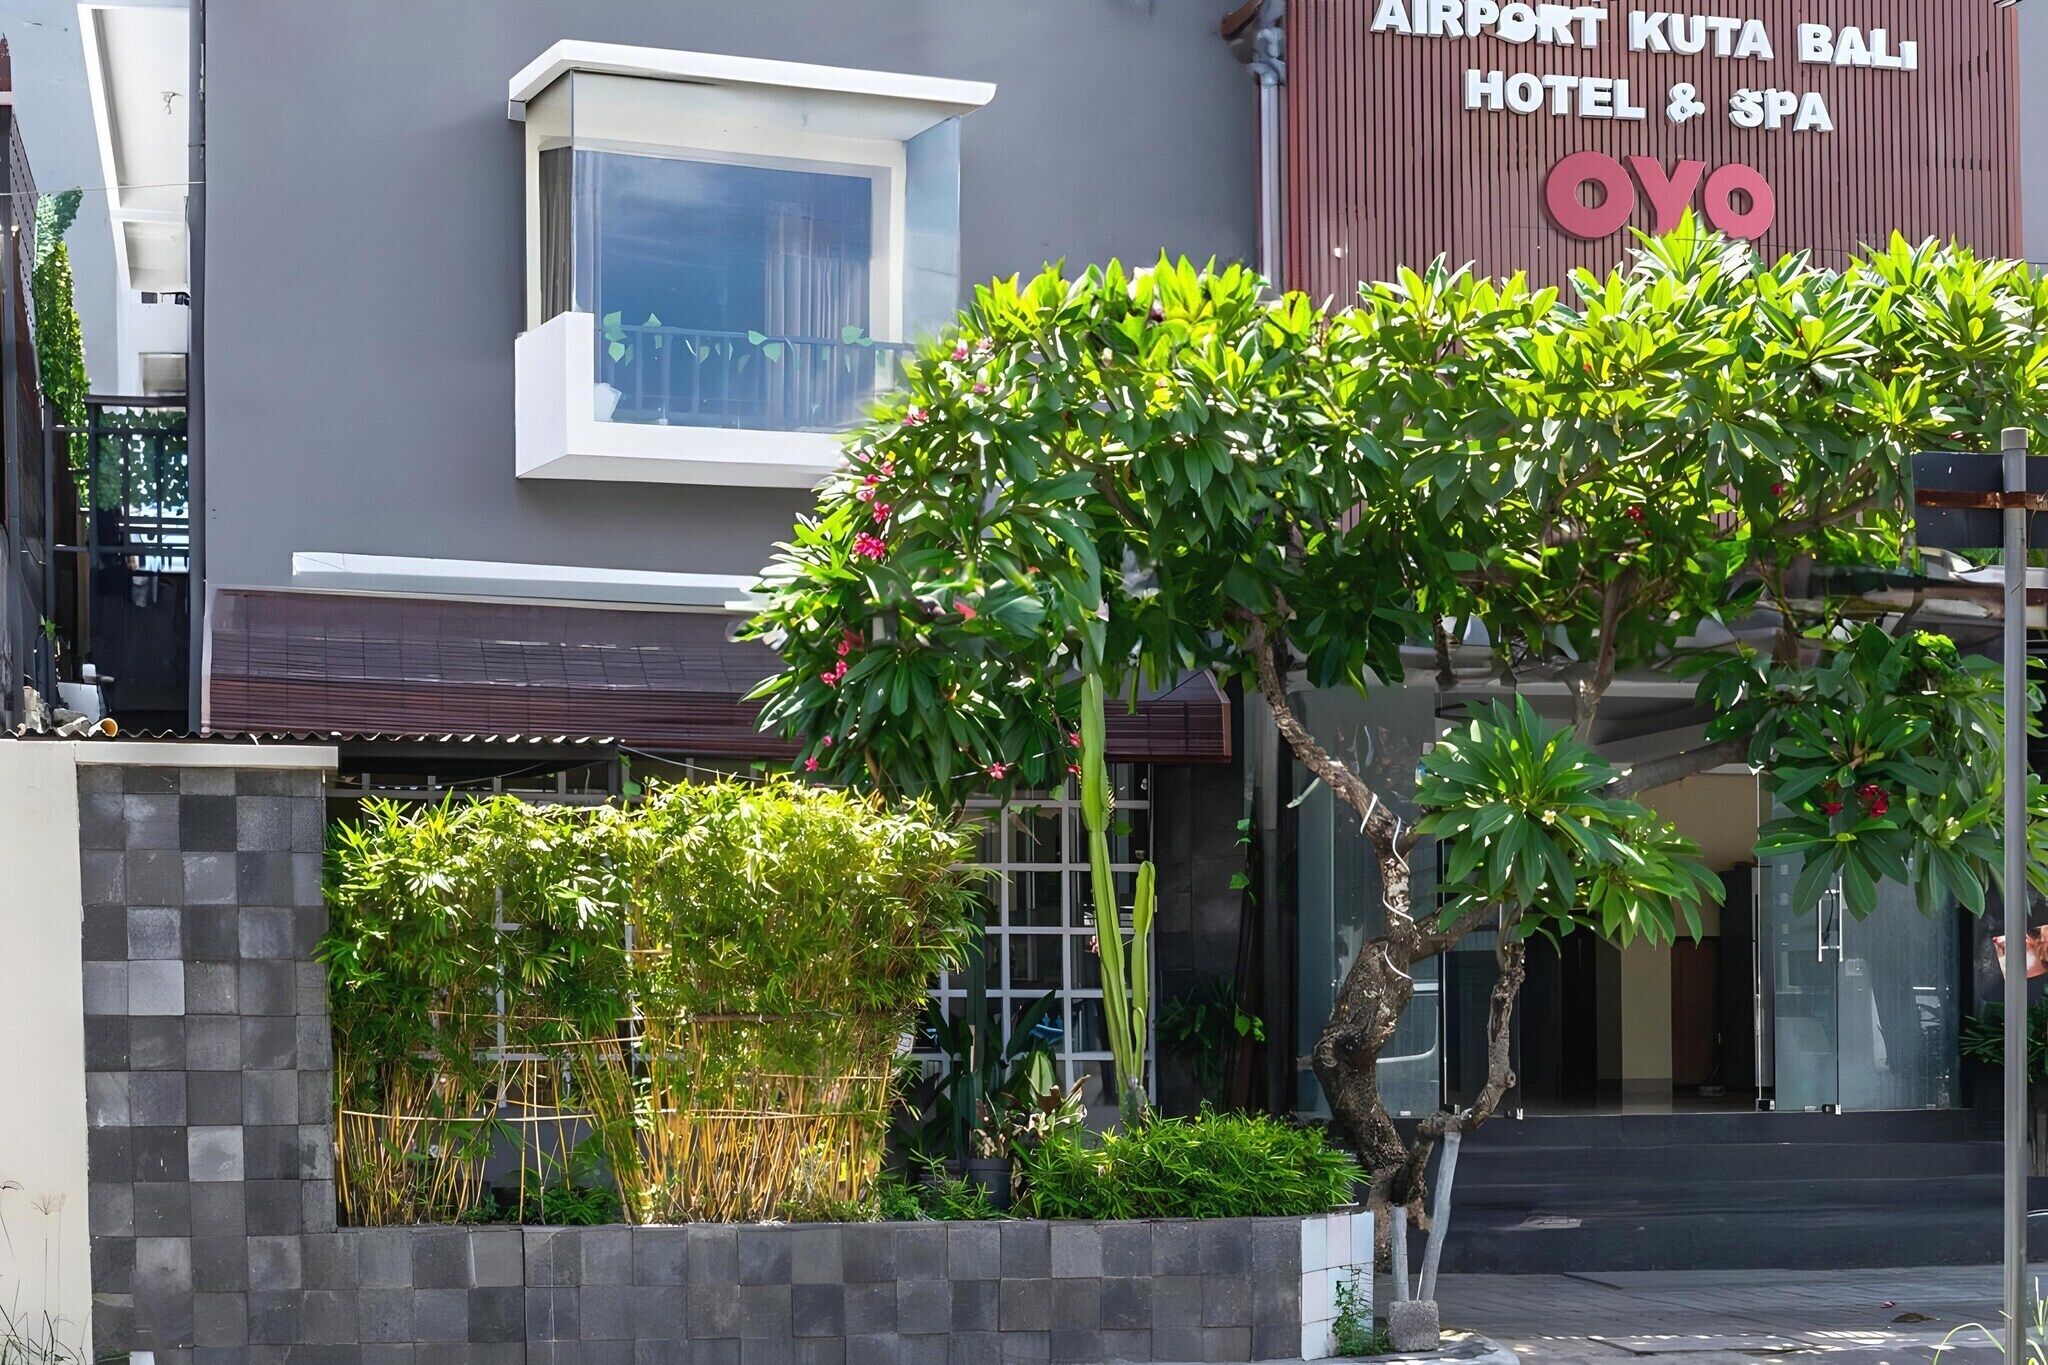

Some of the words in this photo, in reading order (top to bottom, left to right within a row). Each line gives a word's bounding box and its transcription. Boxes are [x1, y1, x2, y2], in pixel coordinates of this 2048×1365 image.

[1370, 0, 1608, 49] AIRPORT
[1628, 10, 1774, 61] KUTA
[1464, 69, 1646, 120] HOTEL
[1666, 82, 1706, 124] &
[1728, 87, 1834, 132] SPA
[1546, 150, 1775, 240] OYO
